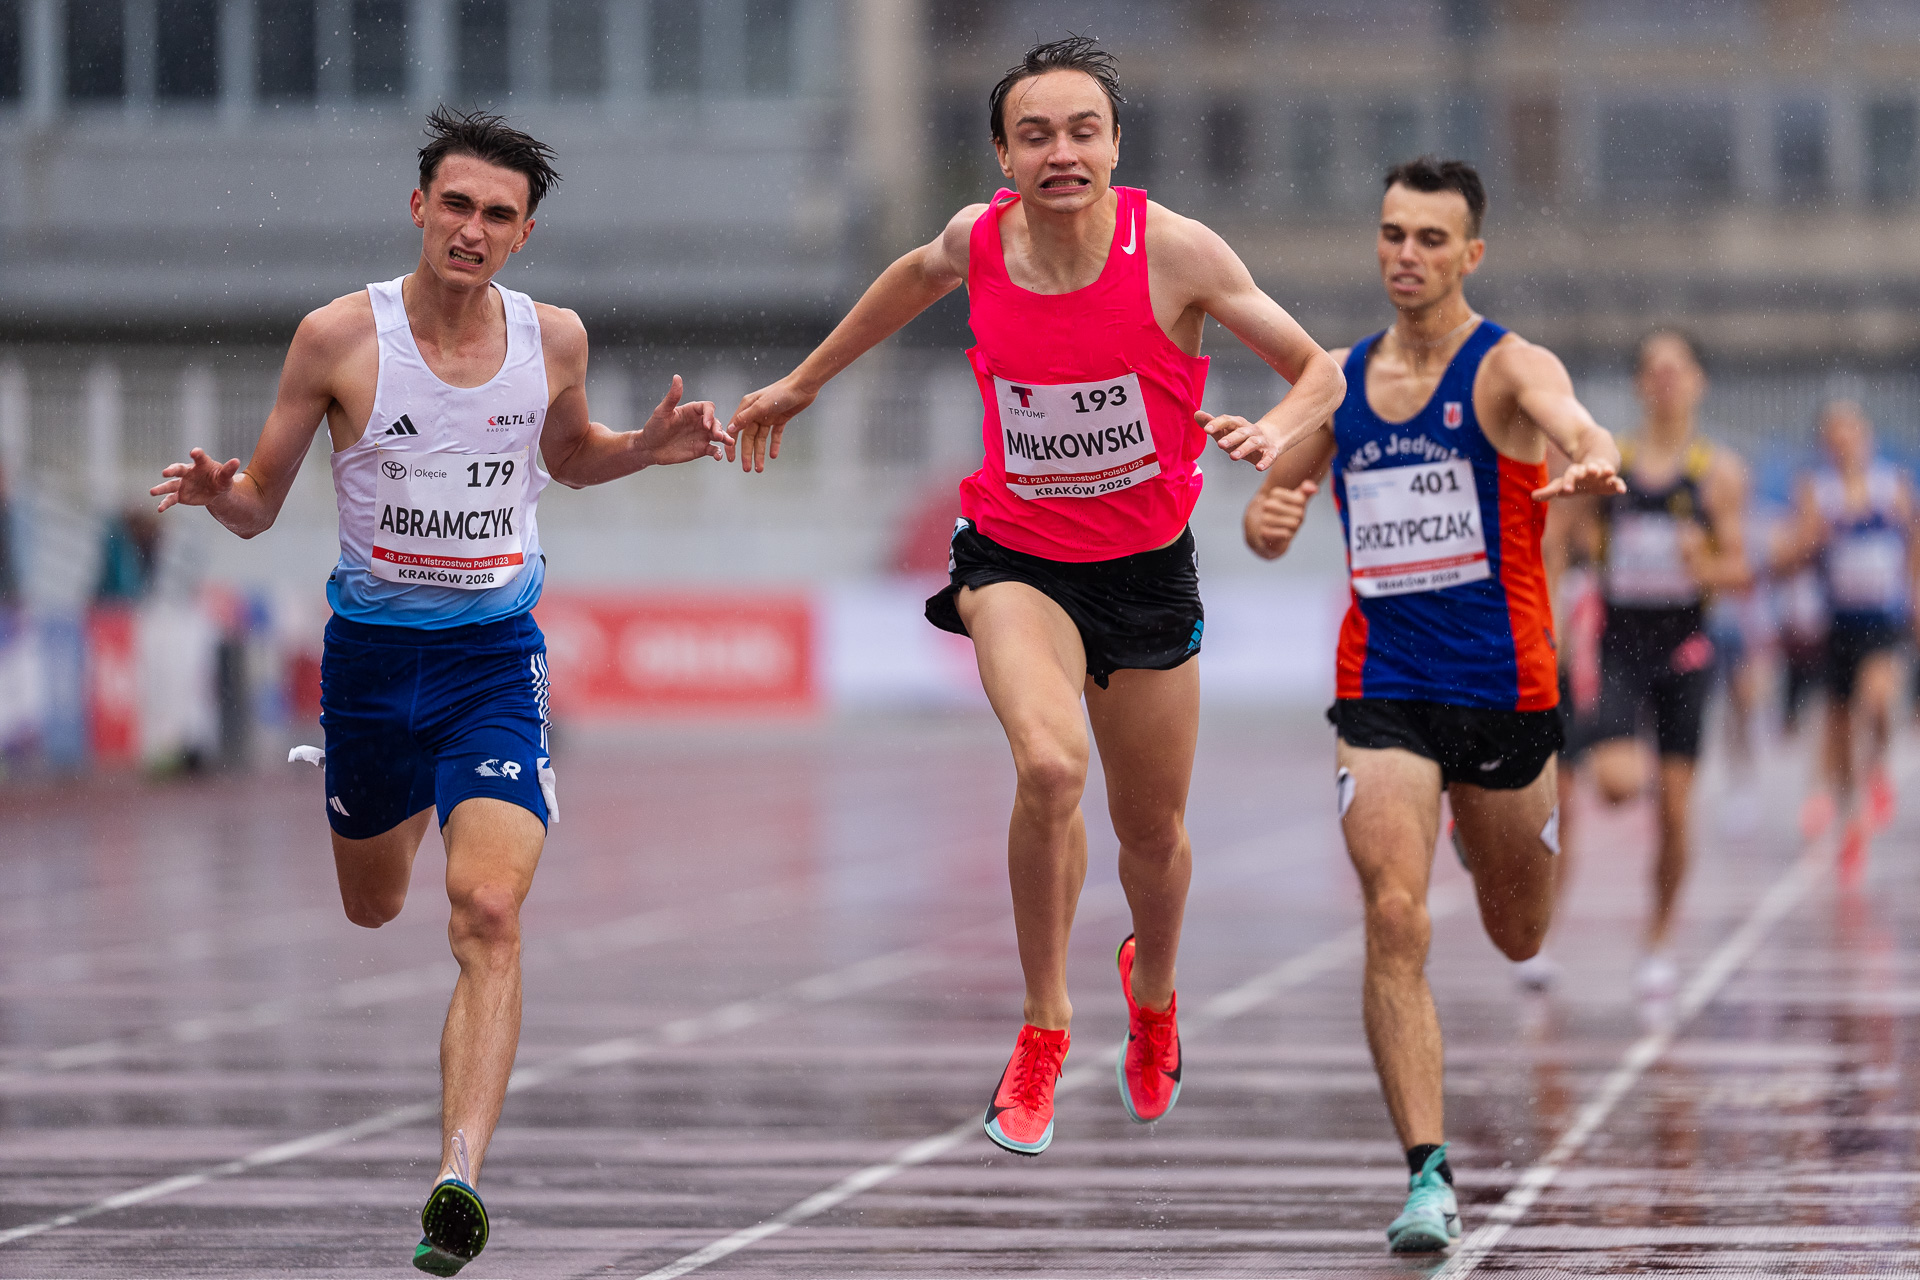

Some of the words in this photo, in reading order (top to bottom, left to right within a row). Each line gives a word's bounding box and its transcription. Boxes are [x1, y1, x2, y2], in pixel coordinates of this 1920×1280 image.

[1070, 385, 1128, 413] 193
[497, 415, 525, 426] RLTL
[1008, 408, 1046, 419] TRYUMF
[1006, 420, 1145, 461] MIŁKOWSKI
[414, 468, 447, 480] Okęcie
[466, 460, 515, 488] 179
[1030, 476, 1050, 484] PZLA
[1051, 473, 1102, 482] Mistrzostwa
[1103, 466, 1128, 478] Polski
[1128, 459, 1144, 471] U23
[1410, 470, 1460, 495] 401
[1035, 484, 1095, 496] KRAKÓW
[1099, 477, 1132, 492] 2026
[379, 504, 514, 540] ABRAMCZYK
[1355, 510, 1474, 550] SKRZYPCZAK
[384, 551, 396, 562] 43.
[397, 554, 418, 565] PZLA
[419, 556, 472, 569] Mistrzostwa
[473, 559, 493, 568] Polski
[494, 556, 509, 565] U23
[398, 568, 463, 584] KRAKÓW
[465, 572, 495, 585] 2026
